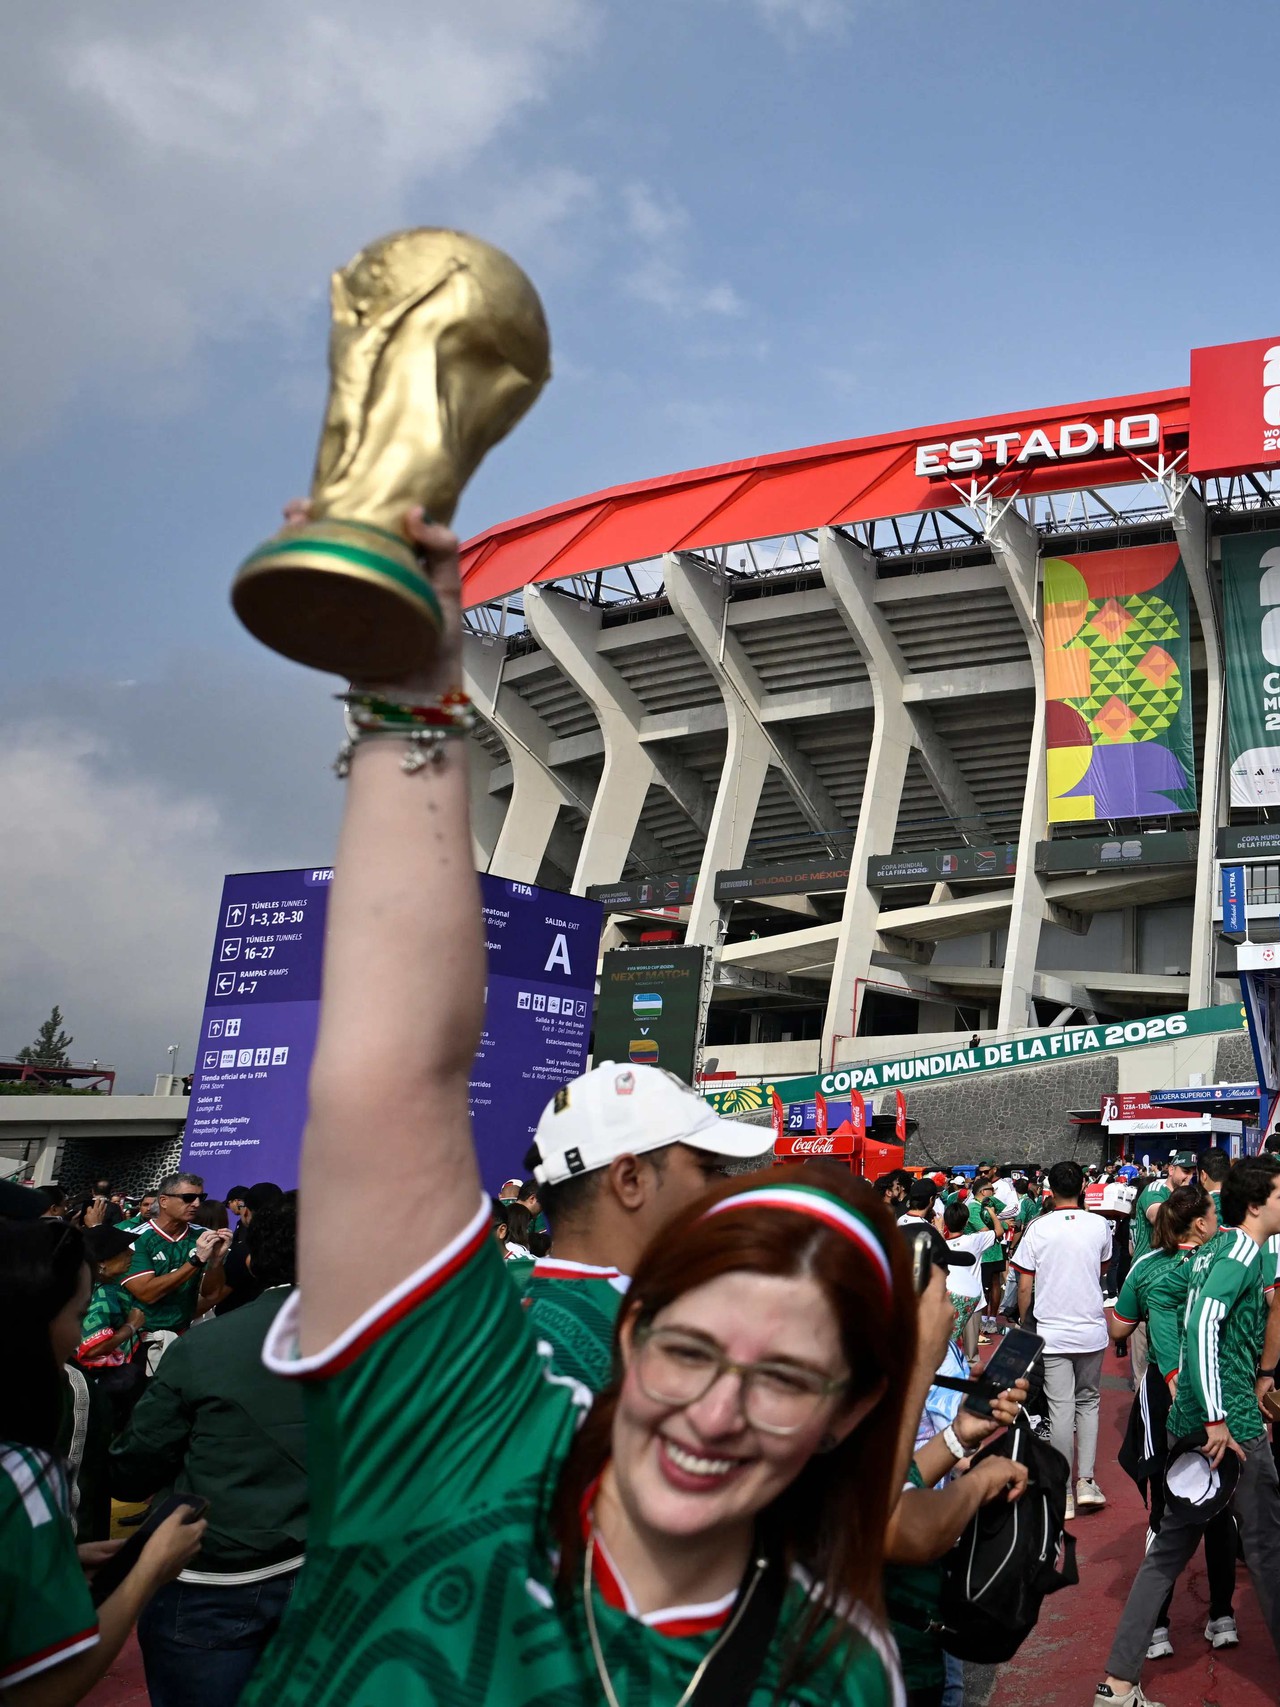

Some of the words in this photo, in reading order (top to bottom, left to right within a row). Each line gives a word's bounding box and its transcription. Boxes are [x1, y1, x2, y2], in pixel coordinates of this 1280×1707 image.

[915, 413, 1159, 477] ESTADIO
[1241, 835, 1260, 843] COPA
[1101, 840, 1142, 859] 26
[898, 862, 924, 870] MUNDIAL
[907, 867, 928, 875] 2026
[754, 875, 793, 886] CIUDAD
[794, 873, 808, 882] DE
[512, 883, 533, 896] FIFA
[251, 901, 280, 910] TÚNELES
[280, 899, 308, 908] TUNNELS
[481, 906, 510, 918] peatonal
[1230, 904, 1238, 929] Michelob
[488, 918, 507, 928] Bridge
[545, 917, 567, 928] SALIDA
[567, 922, 580, 931] EXIT
[246, 935, 274, 944] TÚNELES
[275, 933, 303, 942] TUNNELS
[544, 933, 572, 975] A
[240, 969, 267, 978] RAMPAS
[268, 968, 289, 976] RAMPS
[611, 972, 643, 981] NEXT
[645, 969, 690, 978] MATCH
[545, 1038, 582, 1048] Estacionamiento
[566, 1048, 582, 1057] Parking
[821, 1066, 878, 1094] COPA
[882, 1050, 981, 1083] MUNDIAL
[984, 1045, 1013, 1066] DE
[1016, 1040, 1046, 1060] LA
[1050, 1028, 1100, 1055] FIFA
[1104, 1015, 1188, 1046] 2026
[532, 1065, 562, 1074] compartidos
[562, 1068, 579, 1076] Cantera
[201, 1073, 220, 1081] Tienda
[220, 1072, 239, 1080] oficial
[547, 1074, 563, 1082] Sharing
[211, 1082, 225, 1090] Store
[197, 1096, 213, 1104] Salón
[1158, 1093, 1180, 1101] LIGERA
[1180, 1091, 1212, 1100] SUPERIOR
[1225, 1088, 1255, 1098] Michelob
[196, 1105, 215, 1113] Lounge
[193, 1118, 210, 1126] Zonas
[219, 1116, 251, 1126] hospitality
[790, 1115, 803, 1128] 29
[192, 1126, 219, 1135] Hospitality
[219, 1126, 237, 1134] Village
[210, 1141, 223, 1149] para
[224, 1138, 260, 1148] trabajadores
[189, 1149, 213, 1157] Workforce
[213, 1148, 232, 1156] Center
